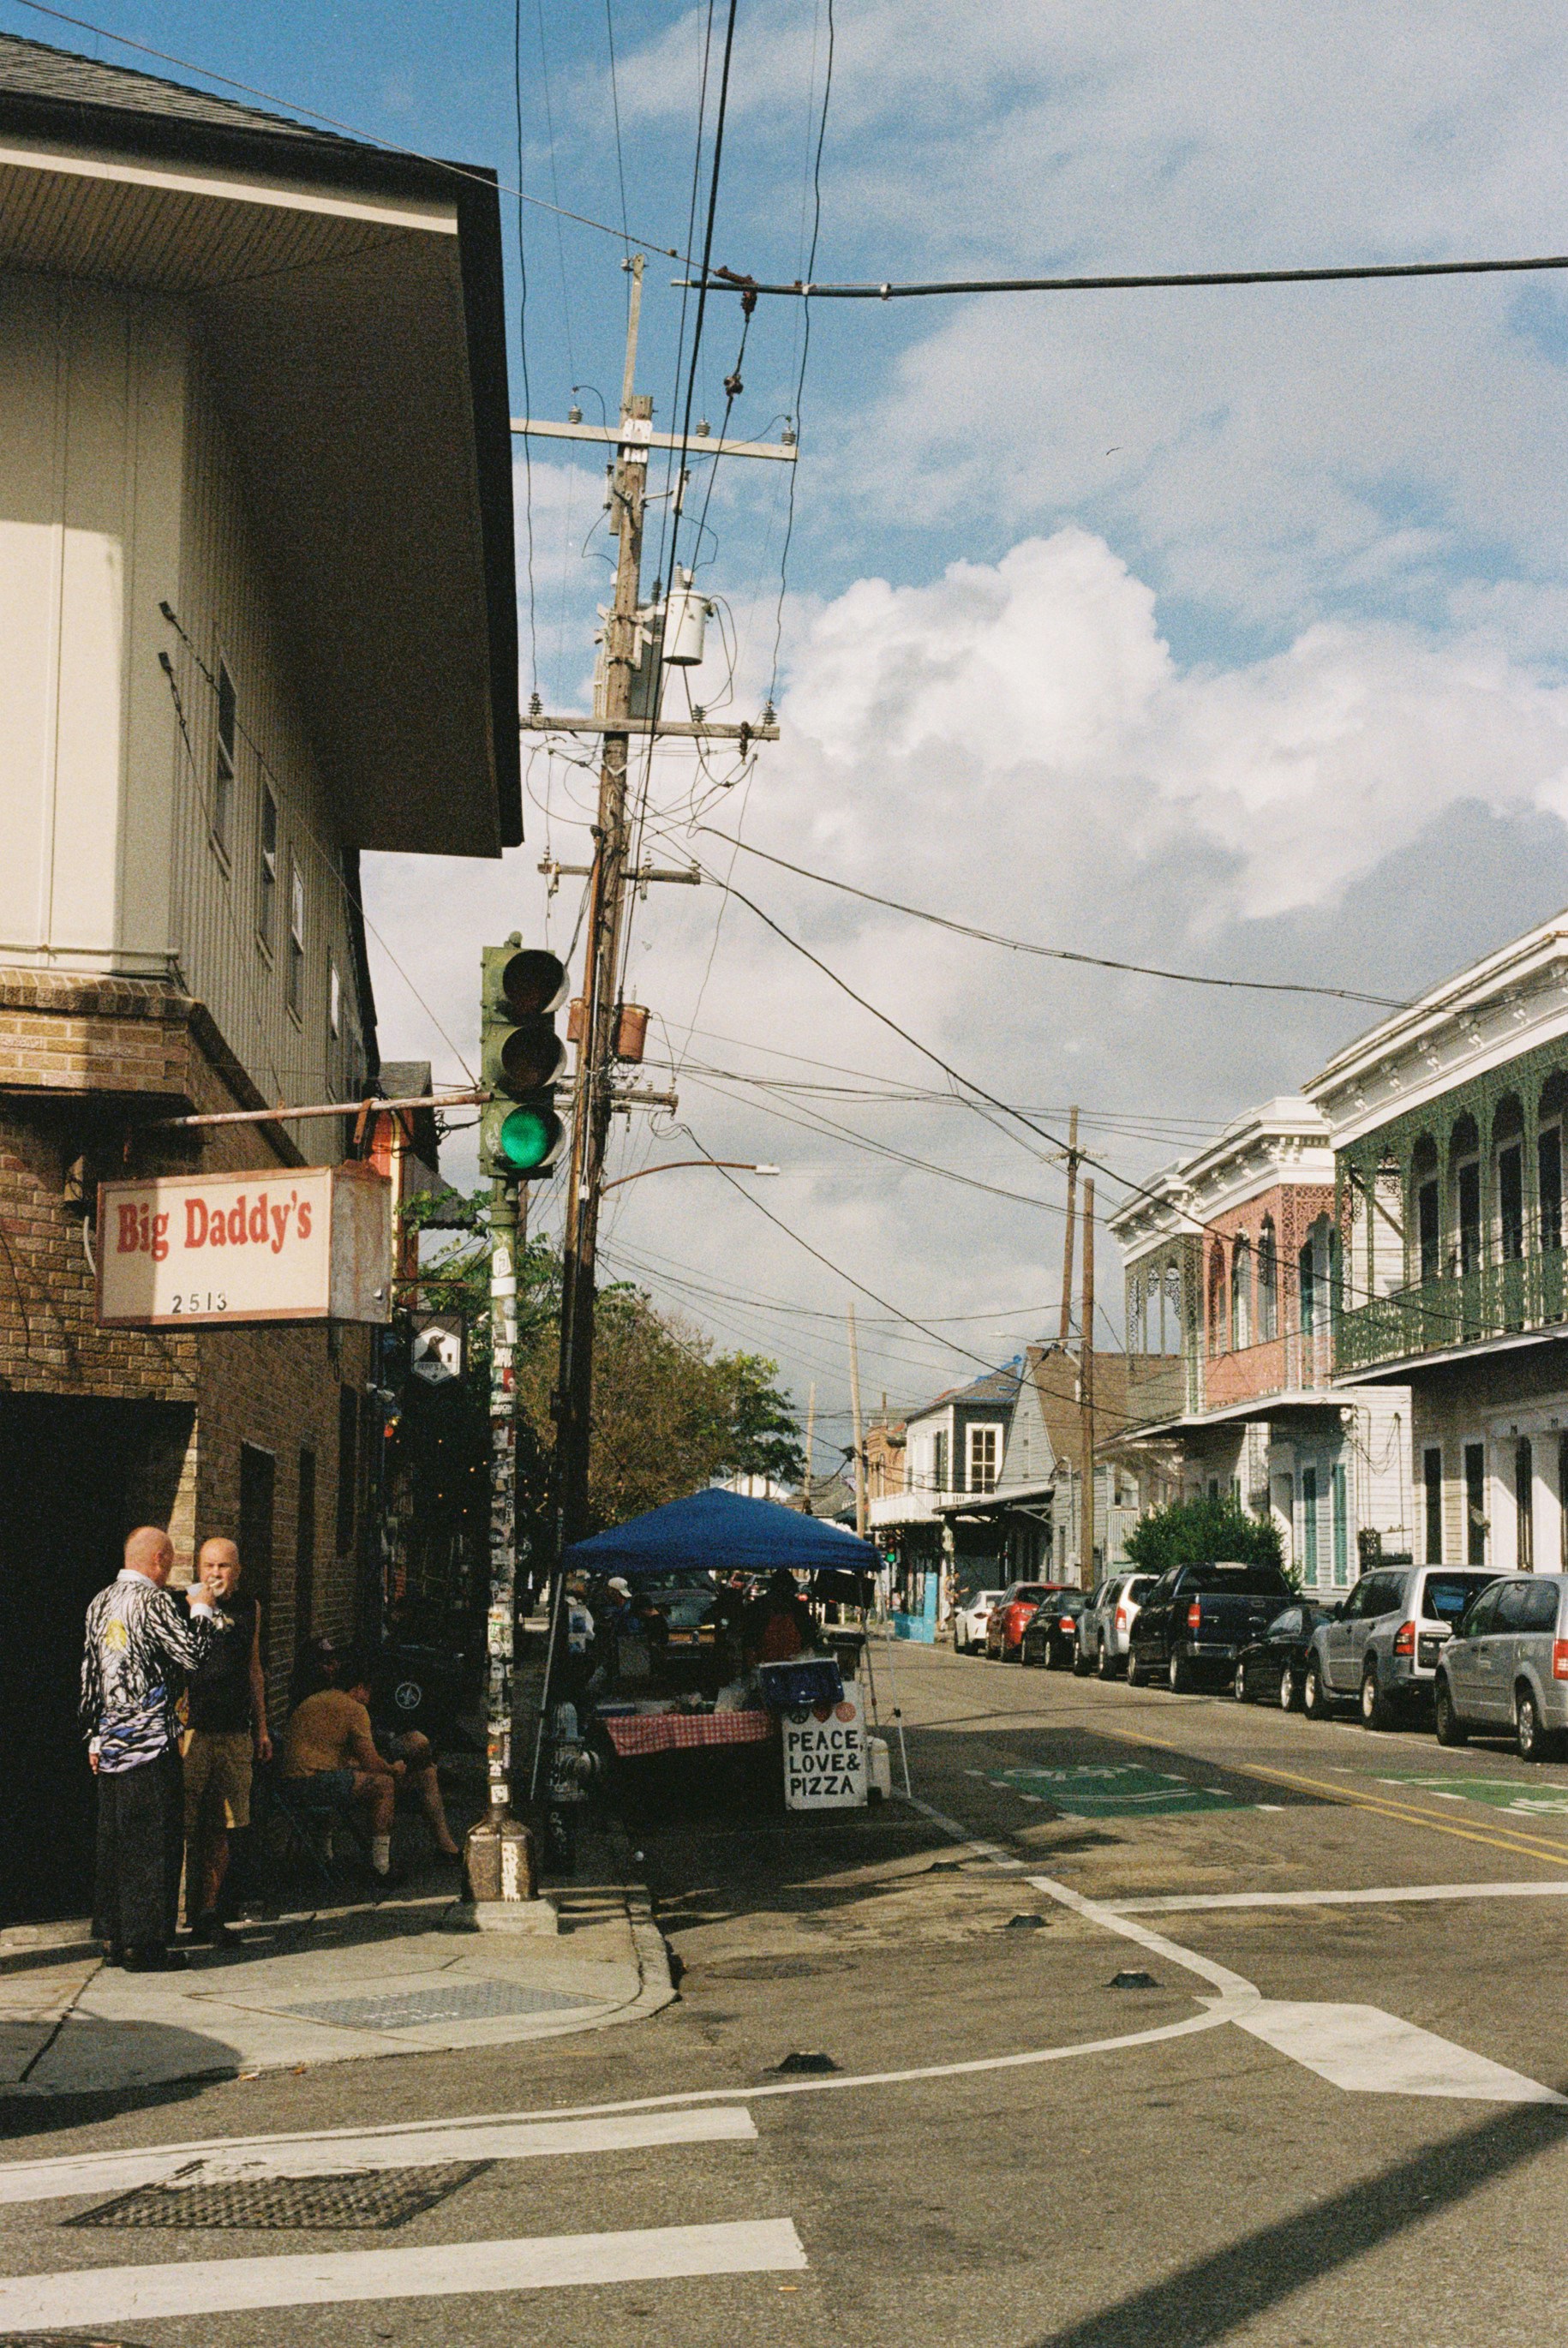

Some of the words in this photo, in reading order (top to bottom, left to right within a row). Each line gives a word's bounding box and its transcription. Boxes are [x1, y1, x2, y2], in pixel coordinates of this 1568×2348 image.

[117, 1202, 170, 1262] Big
[184, 1189, 312, 1255] Daddy's
[171, 1291, 228, 1314] 2513
[788, 1729, 863, 1752] PEACE,
[790, 1775, 855, 1797] PIZZA
